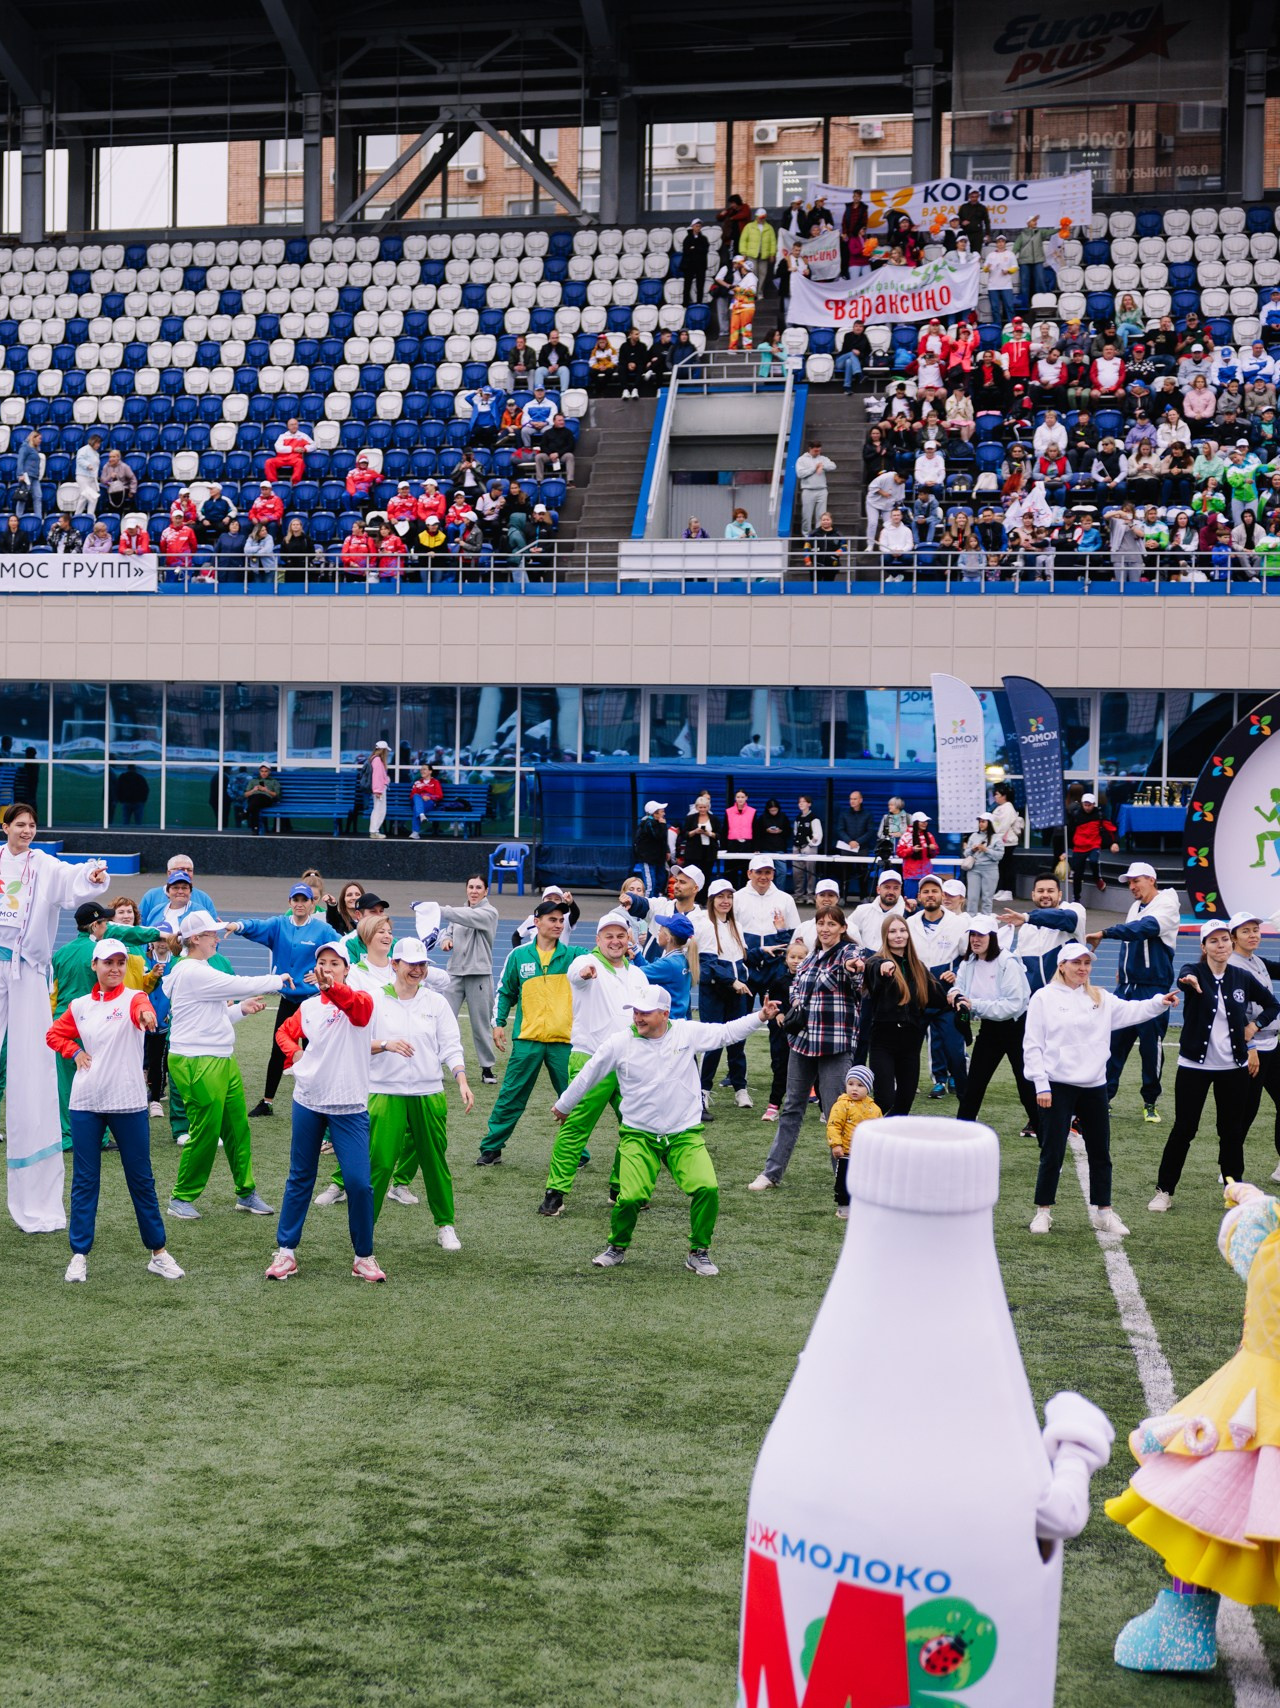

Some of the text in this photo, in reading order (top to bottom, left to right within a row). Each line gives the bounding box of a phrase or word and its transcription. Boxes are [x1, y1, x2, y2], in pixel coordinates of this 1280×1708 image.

[1078, 131, 1153, 150] РОССИИ
[1176, 165, 1208, 177] 103.0
[62, 562, 144, 579] ГРУПП»
